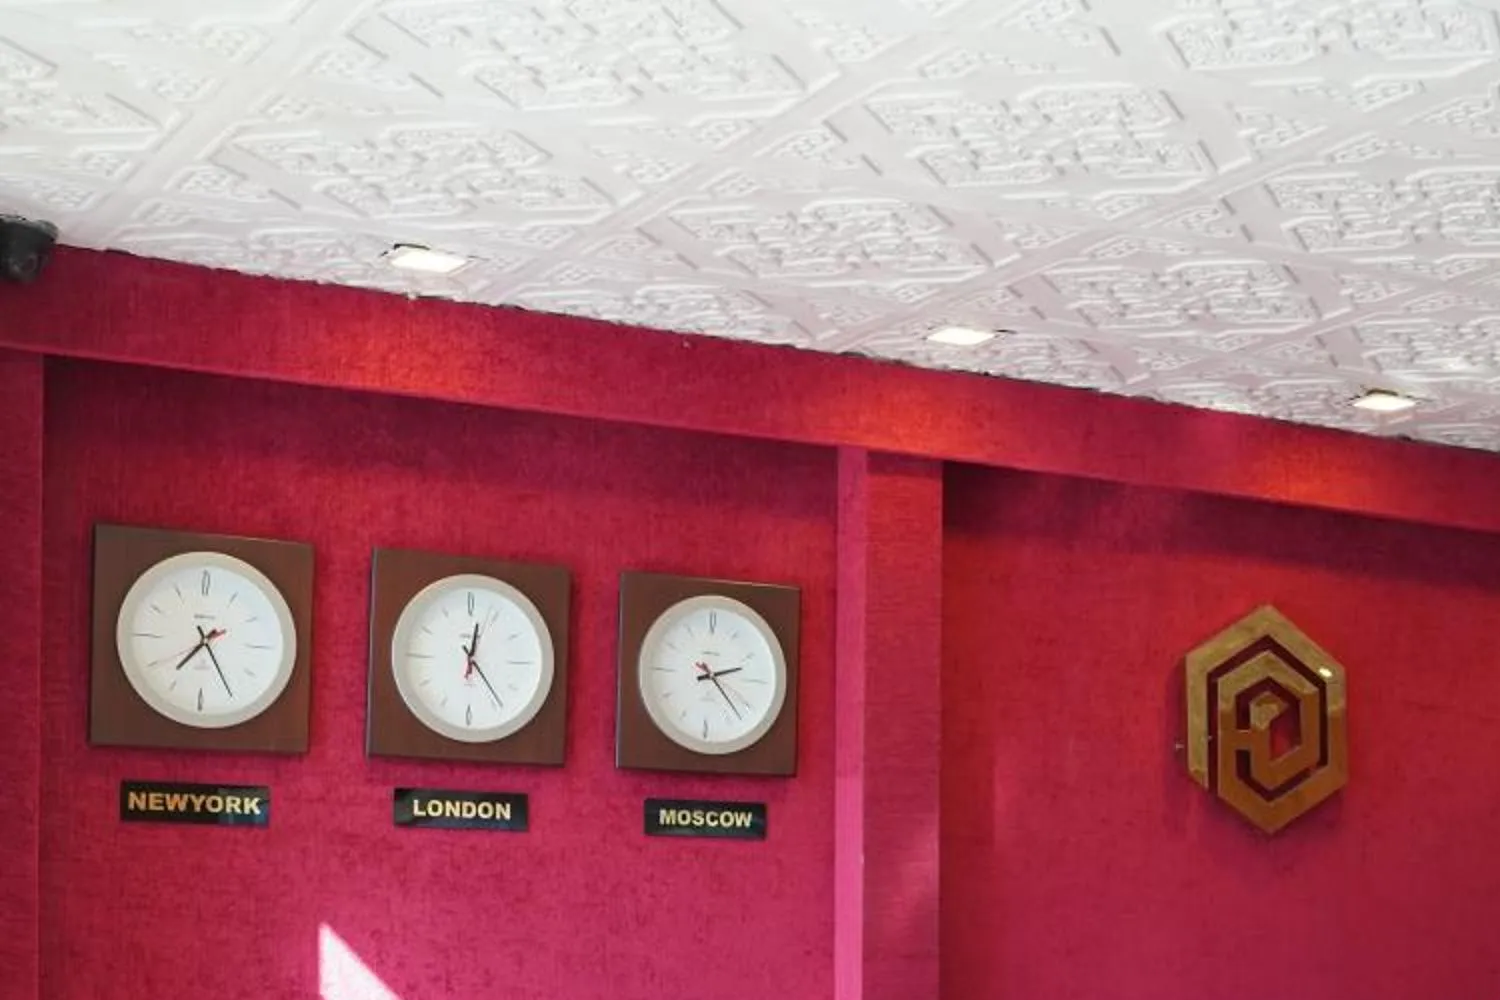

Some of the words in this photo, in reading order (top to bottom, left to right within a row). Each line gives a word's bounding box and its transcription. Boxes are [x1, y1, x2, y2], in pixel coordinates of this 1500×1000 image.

[128, 791, 262, 815] NEWYORK
[412, 799, 512, 821] LONDON
[658, 808, 753, 829] MOSCOW
